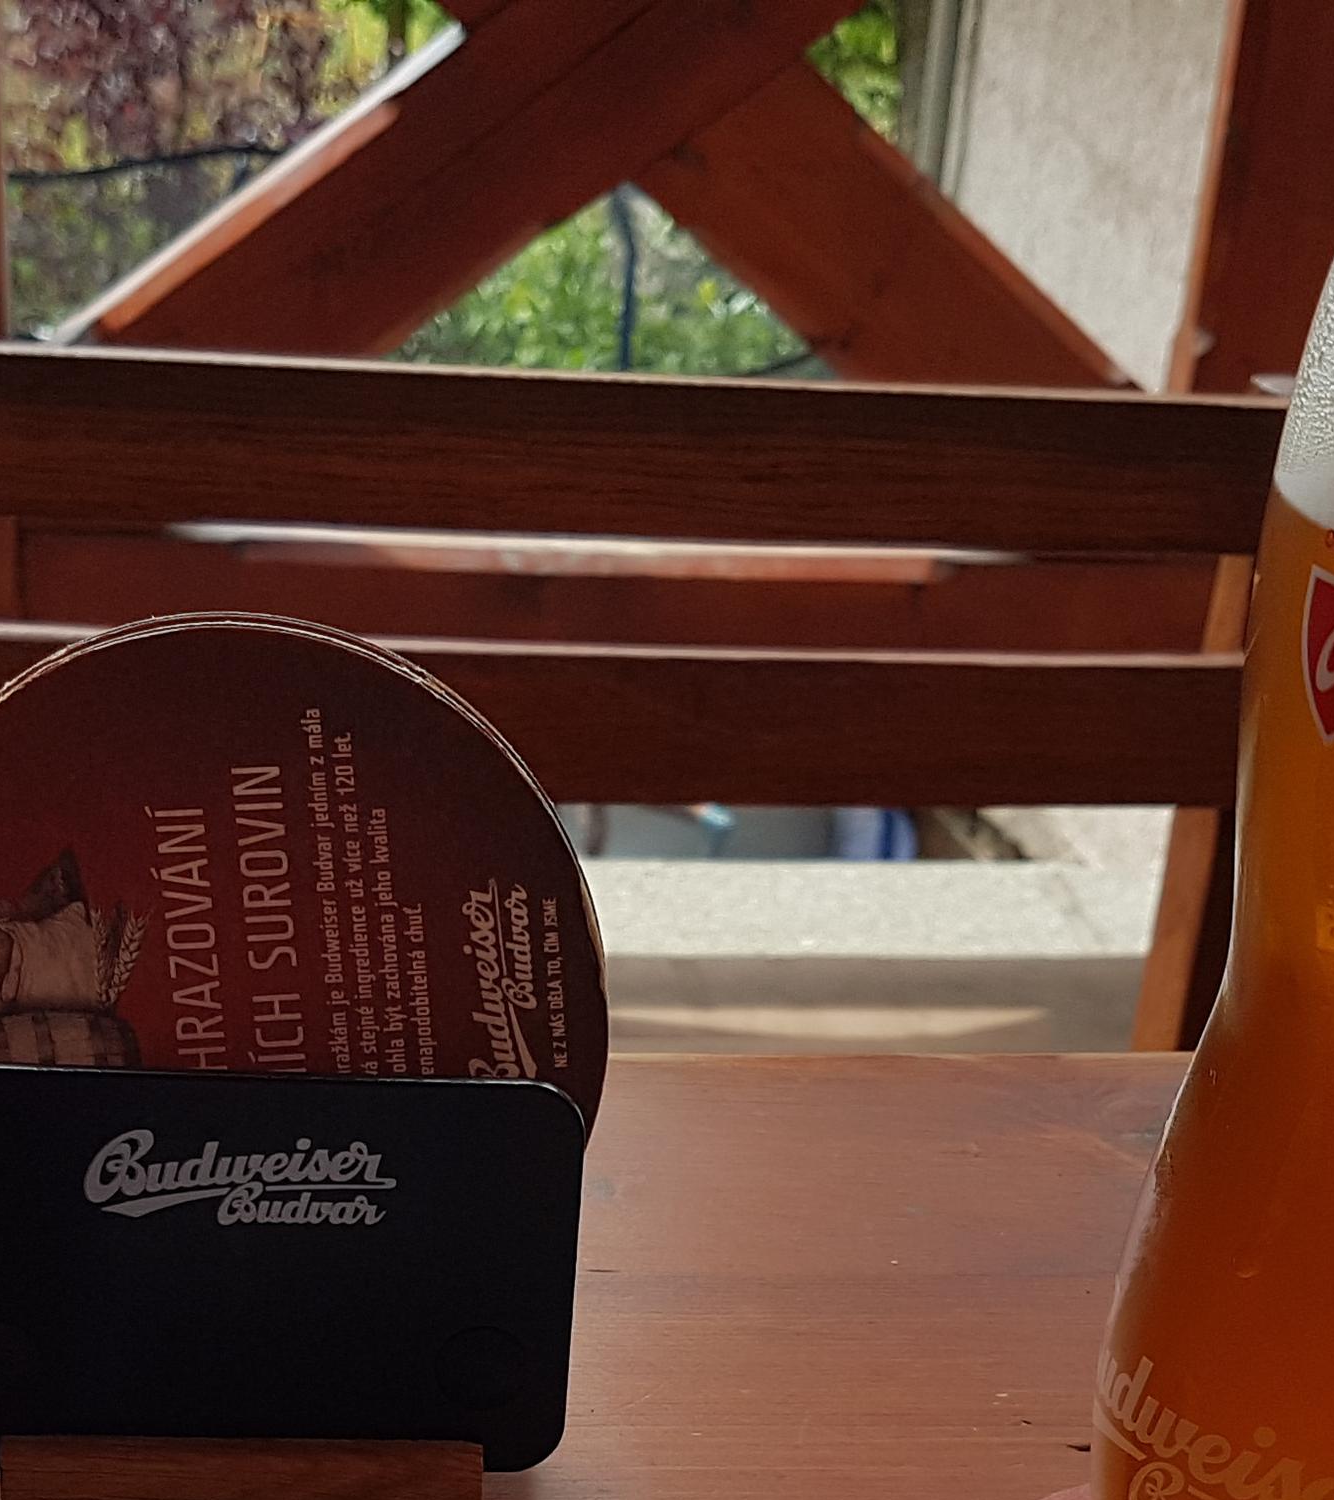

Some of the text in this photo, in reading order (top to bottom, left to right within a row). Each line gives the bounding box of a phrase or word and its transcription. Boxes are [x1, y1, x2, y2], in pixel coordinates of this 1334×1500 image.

[334, 765, 356, 796] 120
[338, 803, 360, 833] než
[367, 808, 391, 864] kvalita
[342, 840, 364, 873] více
[300, 708, 353, 1075] ražkám je Budweiser Budvar jedním z mála
[344, 879, 365, 898] už
[371, 870, 399, 908] jeho
[230, 765, 307, 1073] ÍCH SUROVIN
[348, 904, 377, 1005] ingredience
[374, 913, 402, 1001] zachována
[501, 883, 538, 1010] Budvar
[355, 1006, 381, 1053] stejné
[383, 1003, 409, 1033] být
[83, 1129, 397, 1206] Budweiser
[216, 1181, 388, 1226] Budvar
